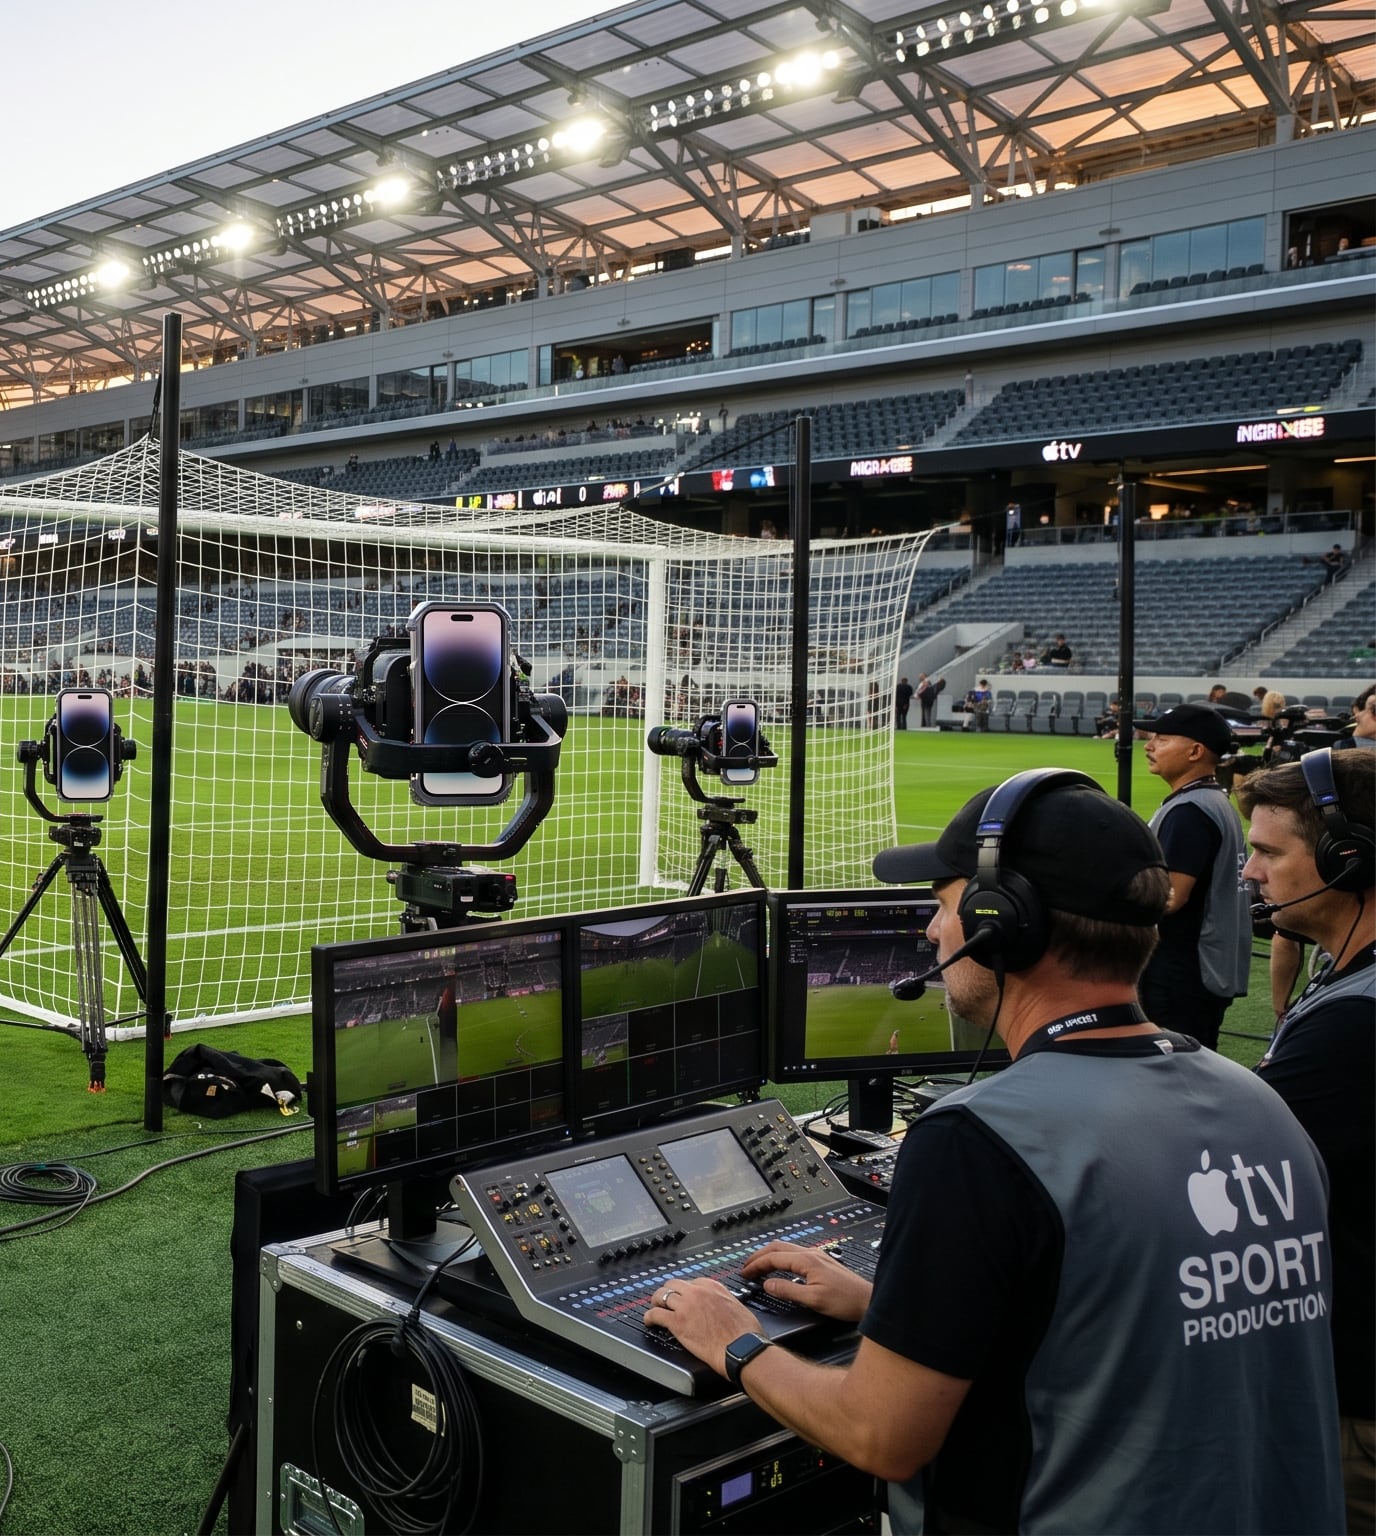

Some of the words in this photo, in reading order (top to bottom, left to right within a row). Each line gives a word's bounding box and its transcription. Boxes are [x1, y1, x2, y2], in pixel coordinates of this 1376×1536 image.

[1060, 440, 1083, 461] tv
[1231, 1153, 1295, 1227] tv
[1179, 1231, 1324, 1310] SPORT
[1183, 1291, 1328, 1347] PRODUCTION
